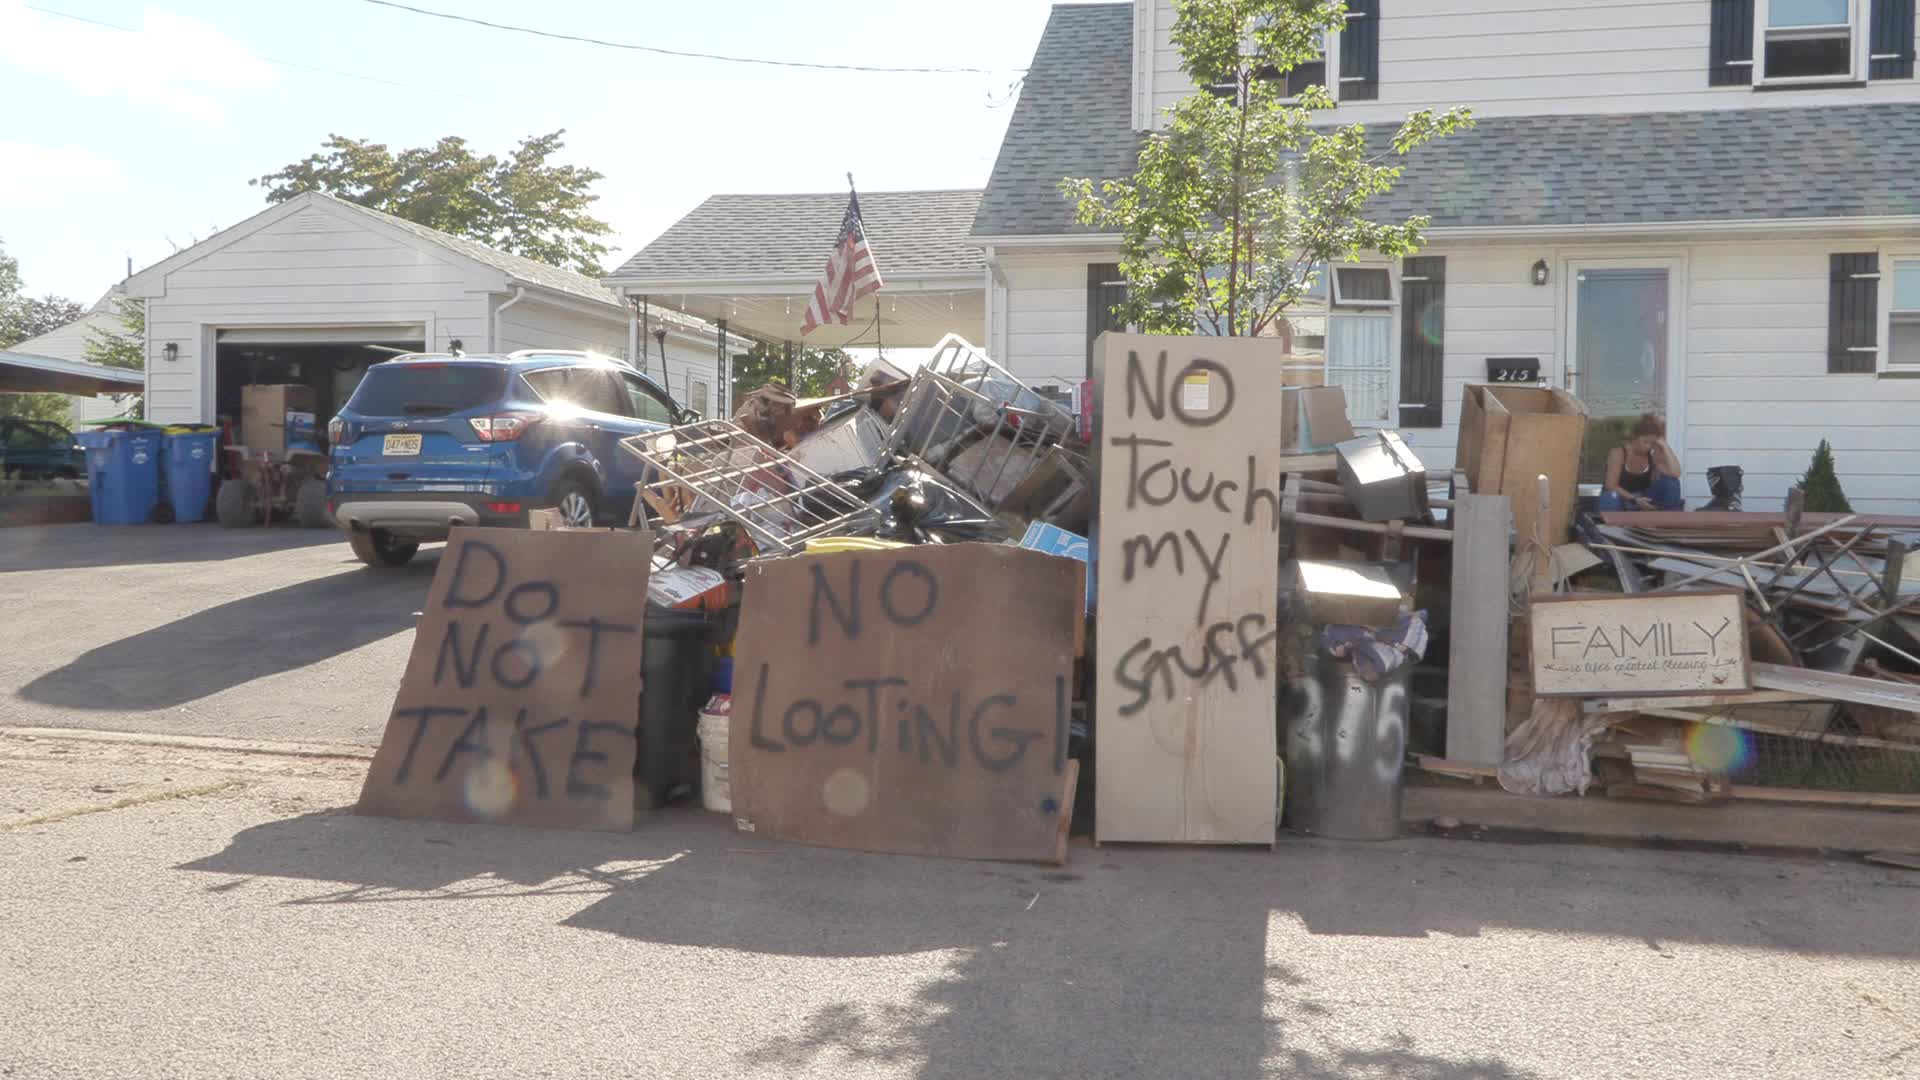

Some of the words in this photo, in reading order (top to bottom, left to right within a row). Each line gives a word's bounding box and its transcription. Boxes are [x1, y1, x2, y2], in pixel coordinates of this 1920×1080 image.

[1126, 350, 1236, 427] NO
[1496, 368, 1530, 381] 215
[1110, 432, 1279, 532] Touch
[806, 558, 939, 645] NO
[1551, 616, 1731, 660] FAMILY
[433, 616, 637, 699] NOT
[395, 706, 638, 799] TAKE
